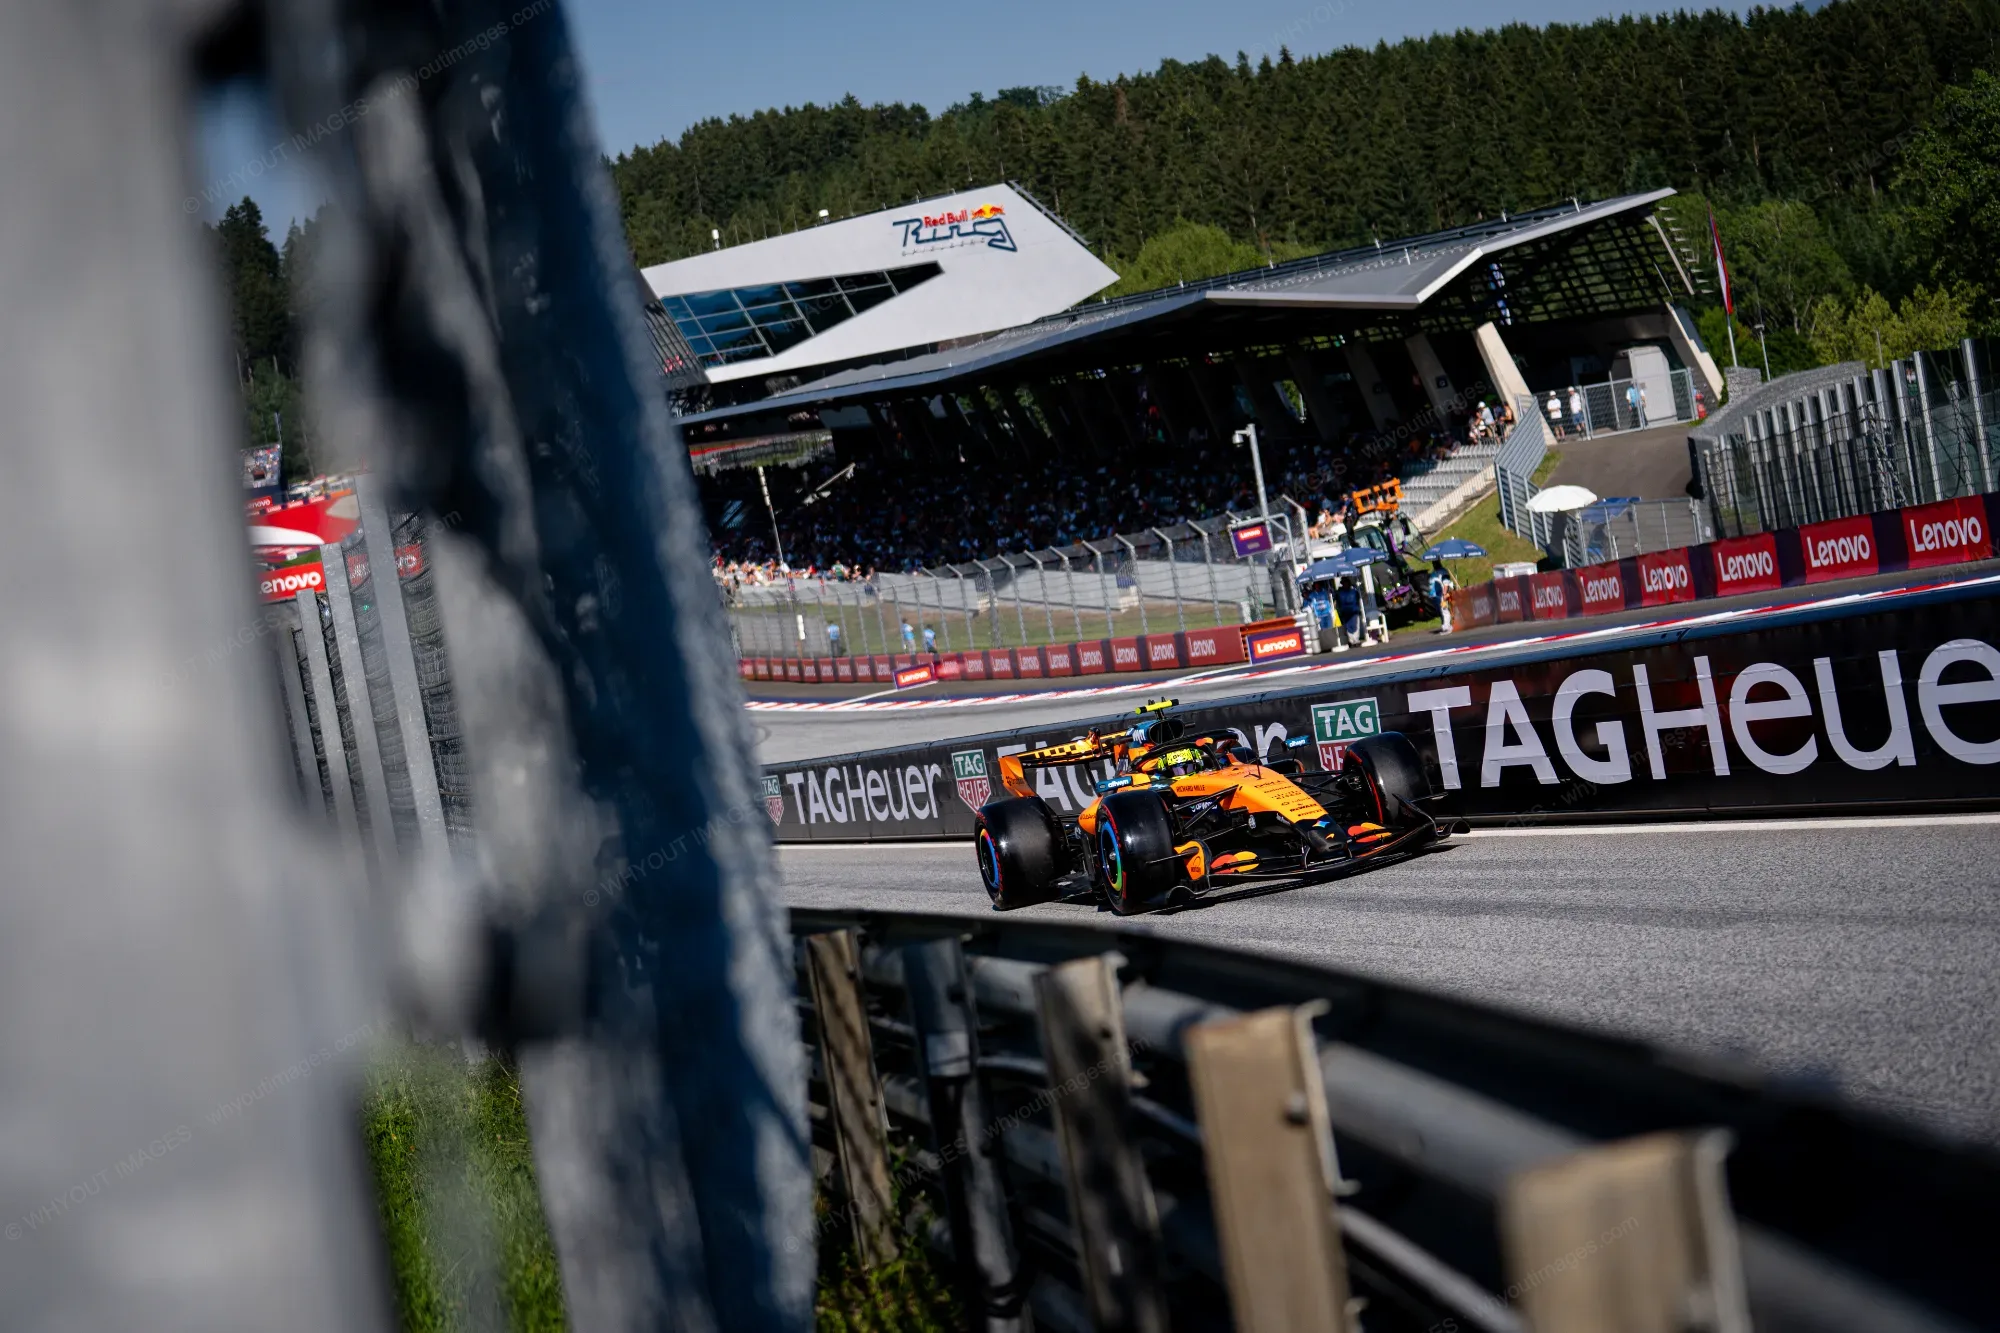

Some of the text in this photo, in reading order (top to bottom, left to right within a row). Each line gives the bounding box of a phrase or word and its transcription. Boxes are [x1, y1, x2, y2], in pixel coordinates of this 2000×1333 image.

[924, 210, 969, 228] Red Bull
[1910, 516, 1982, 552] Lenovo
[1807, 534, 1870, 568] Lenovo
[1718, 551, 1774, 582] Lenovo
[259, 571, 322, 595] enovo
[1580, 576, 1620, 603] Lenovo
[1642, 565, 1688, 593] Lenovo
[1532, 584, 1563, 609] Lenovo
[1114, 646, 1138, 664] Lenovo
[1150, 642, 1175, 662] Lenovo
[1189, 637, 1216, 656] Lenovo
[1257, 637, 1297, 654] Lenovo
[899, 670, 929, 684] Lenovo
[1317, 704, 1374, 738] TAG
[954, 753, 984, 776] TAG
[761, 778, 779, 796] TAG
[958, 780, 990, 809] HEUER
[1176, 784, 1206, 793] RICHARD MILLE
